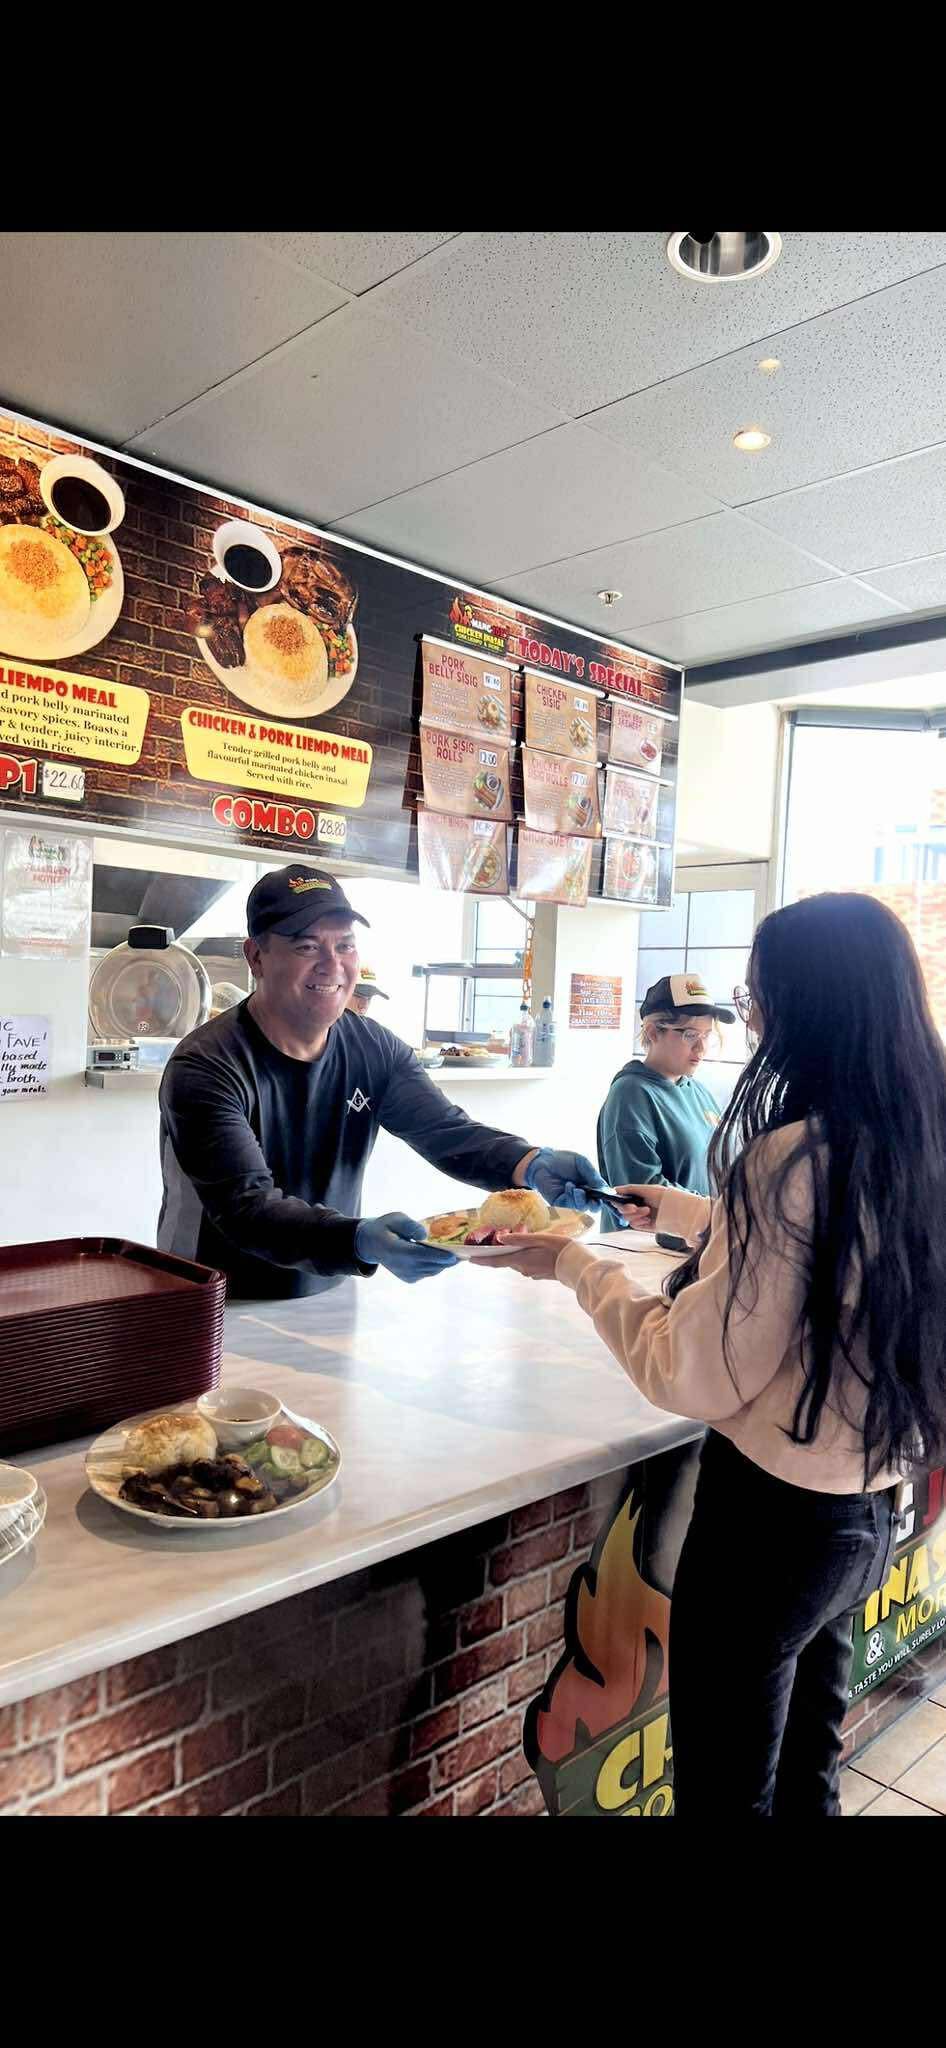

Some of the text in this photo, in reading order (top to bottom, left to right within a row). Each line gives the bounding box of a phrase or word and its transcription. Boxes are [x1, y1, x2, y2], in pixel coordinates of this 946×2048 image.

[429, 663, 478, 687] BELLY SISIG
[441, 655, 465, 671] PORK
[518, 637, 585, 677] TODAY'S
[588, 661, 643, 697] SPECIAL
[0, 667, 118, 708] LIEMPO MEAL
[536, 683, 567, 701] CHICKEN
[12, 694, 40, 706] pork
[43, 698, 70, 713] belly
[73, 707, 130, 725] marinated
[542, 696, 561, 710] SISIG
[8, 719, 16, 729] &
[64, 730, 92, 744] juicy
[94, 736, 140, 753] interior.
[42, 713, 80, 728] spices.
[84, 720, 119, 736] Boasts
[188, 710, 369, 765] CHICKEN & PORK LIEMPO MEAL
[22, 737, 48, 750] with
[51, 743, 76, 755] rice.
[425, 731, 474, 754] PORK SISIG
[436, 747, 463, 763] ROLLS
[207, 750, 348, 786] flavourful marinated chicken inasal
[222, 742, 336, 773] Tender grilled pork belly and
[245, 770, 313, 790] Served with rice.
[212, 794, 316, 839] COMBO
[2, 1050, 38, 1061] based
[854, 1670, 878, 1695] TASTE
[878, 1657, 894, 1675] YOU
[894, 1645, 912, 1663] WILL
[911, 1624, 936, 1649] SURELY
[935, 1614, 946, 1629] LO
[866, 1631, 885, 1665] &
